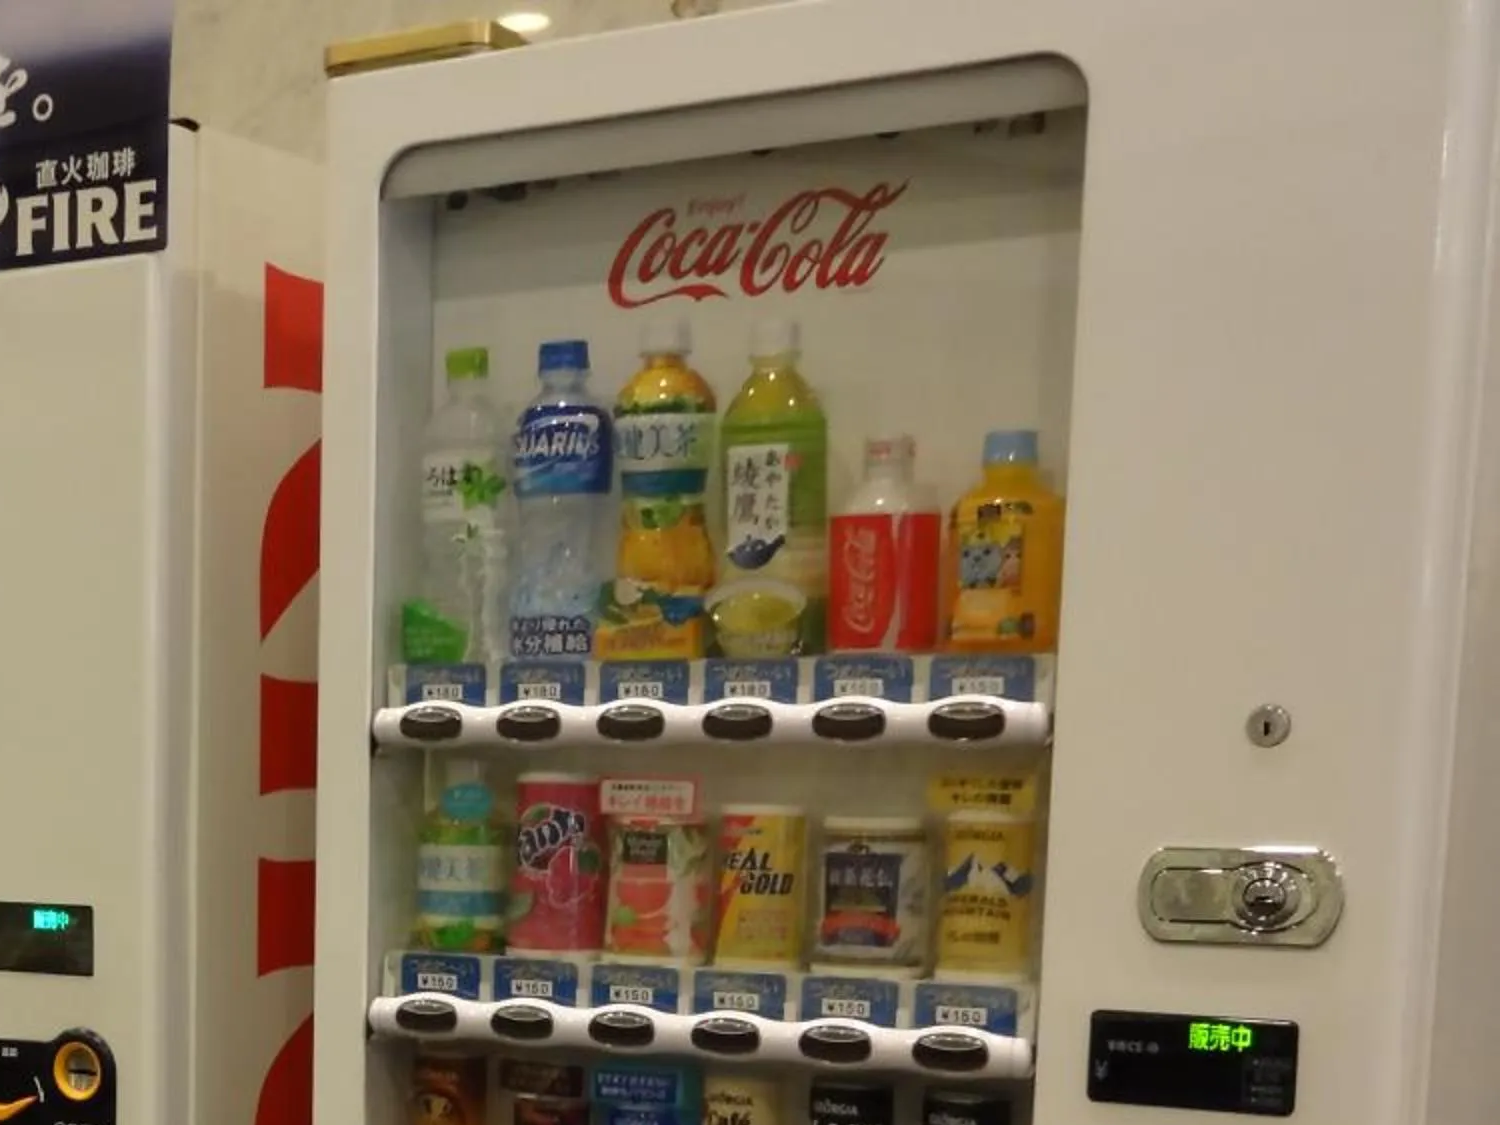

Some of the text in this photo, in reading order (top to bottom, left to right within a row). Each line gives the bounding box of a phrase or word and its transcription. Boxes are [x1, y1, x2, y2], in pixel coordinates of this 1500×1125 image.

[35, 148, 136, 190] 直火珈琲
[15, 179, 159, 256] FIRE
[607, 177, 911, 309] Coca-Cola
[517, 807, 586, 871] anta
[740, 872, 795, 897] GOLD
[1188, 1022, 1252, 1052] 販売中
